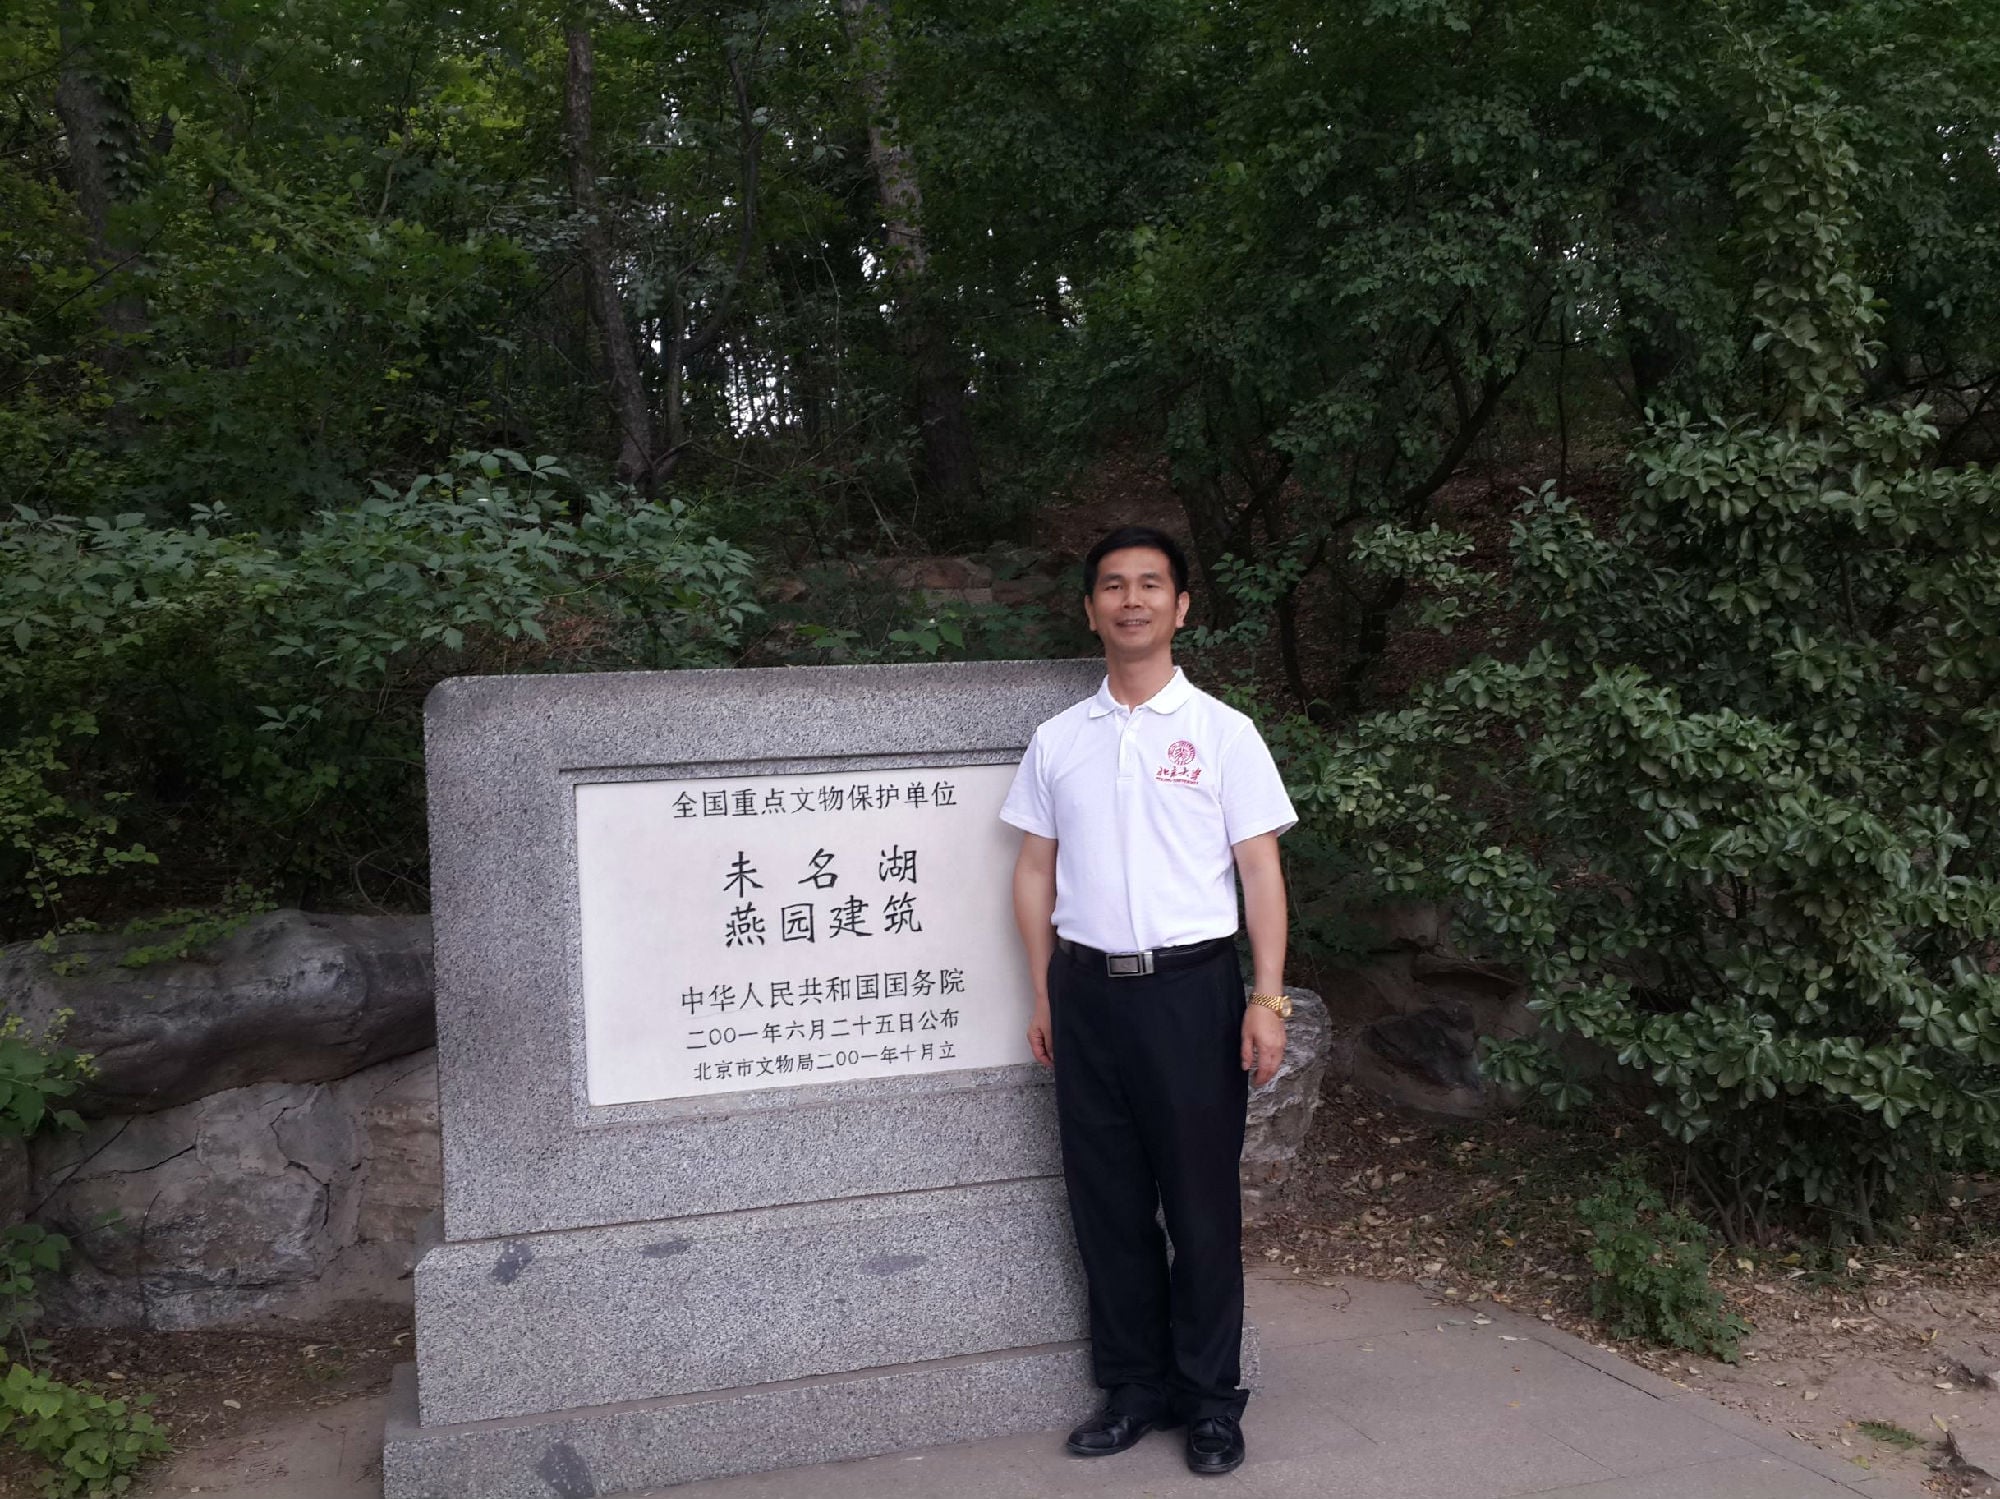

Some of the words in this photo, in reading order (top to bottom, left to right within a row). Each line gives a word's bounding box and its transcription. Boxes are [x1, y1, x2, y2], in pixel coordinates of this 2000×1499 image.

[672, 781, 957, 819] 全国重点文物保护单位
[723, 844, 917, 898] 未名湖
[725, 891, 923, 948] 燕园建筑
[682, 968, 965, 1015] 中华人民共和国国务院
